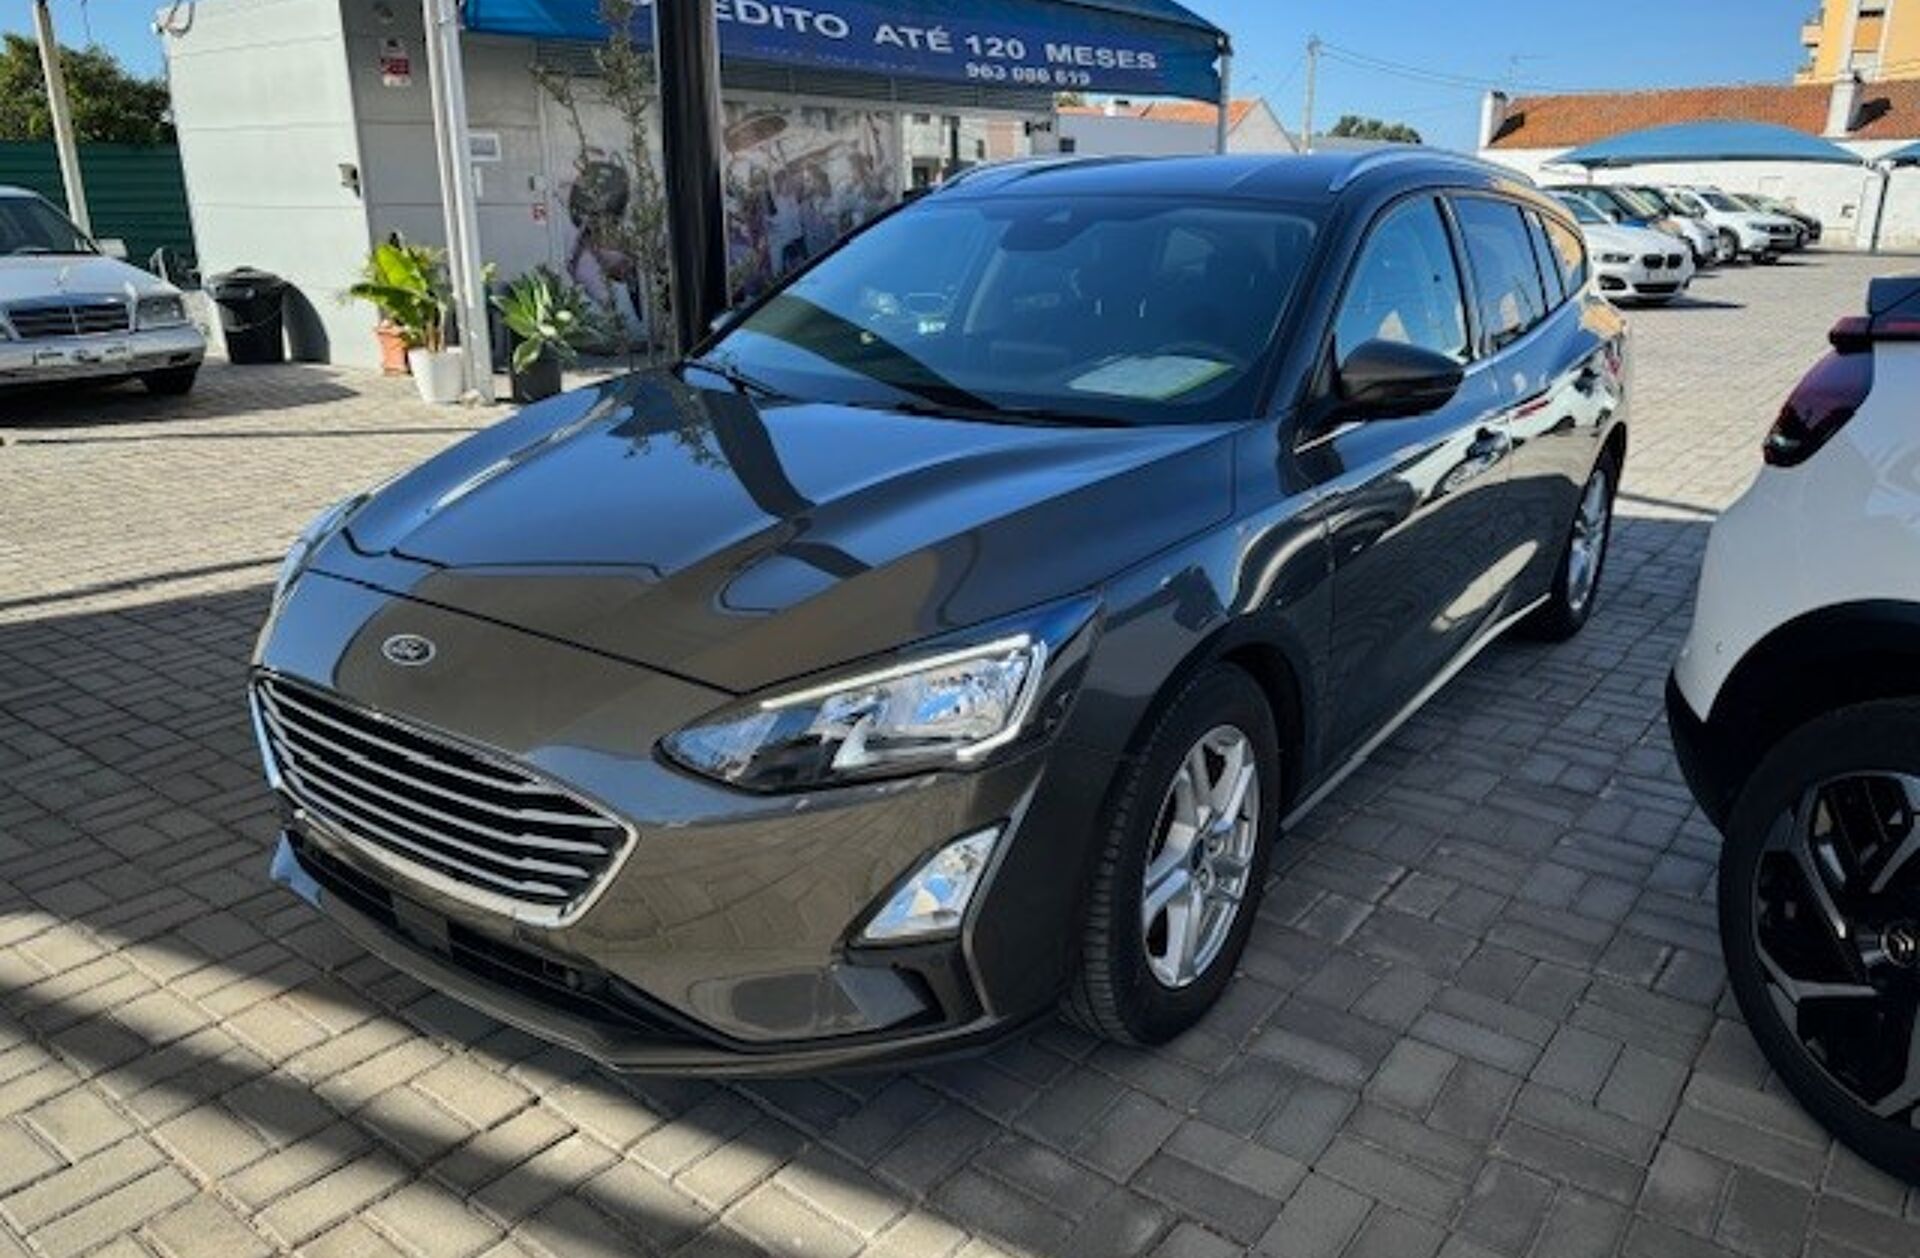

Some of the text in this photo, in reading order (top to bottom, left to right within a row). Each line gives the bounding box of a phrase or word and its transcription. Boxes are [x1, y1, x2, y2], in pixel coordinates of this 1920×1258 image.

[874, 24, 953, 54] ATÉ
[965, 34, 1026, 60] 120
[1045, 43, 1157, 69] MESES
